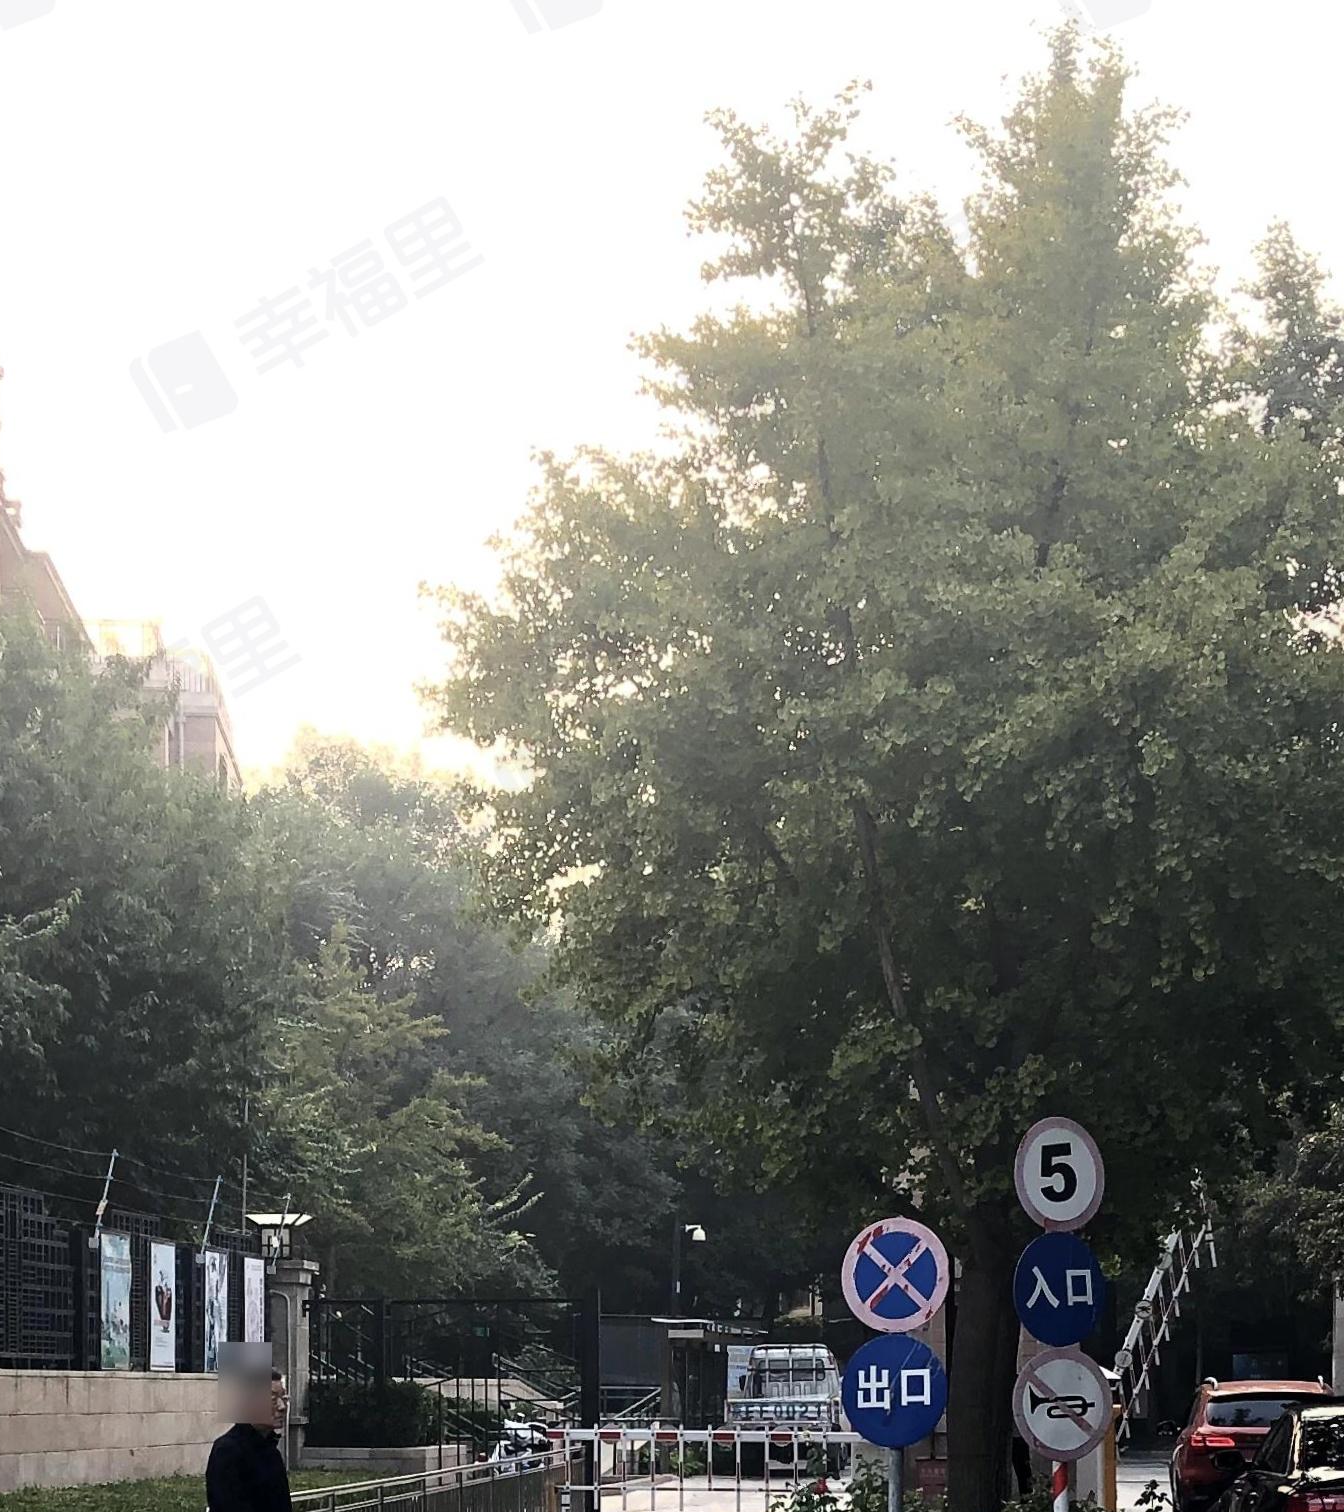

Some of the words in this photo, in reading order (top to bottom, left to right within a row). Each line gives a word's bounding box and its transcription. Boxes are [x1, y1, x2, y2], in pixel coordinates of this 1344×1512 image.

[1039, 1142, 1078, 1203] 5
[1025, 1268, 1095, 1309] 入口
[856, 1364, 931, 1410] 出口
